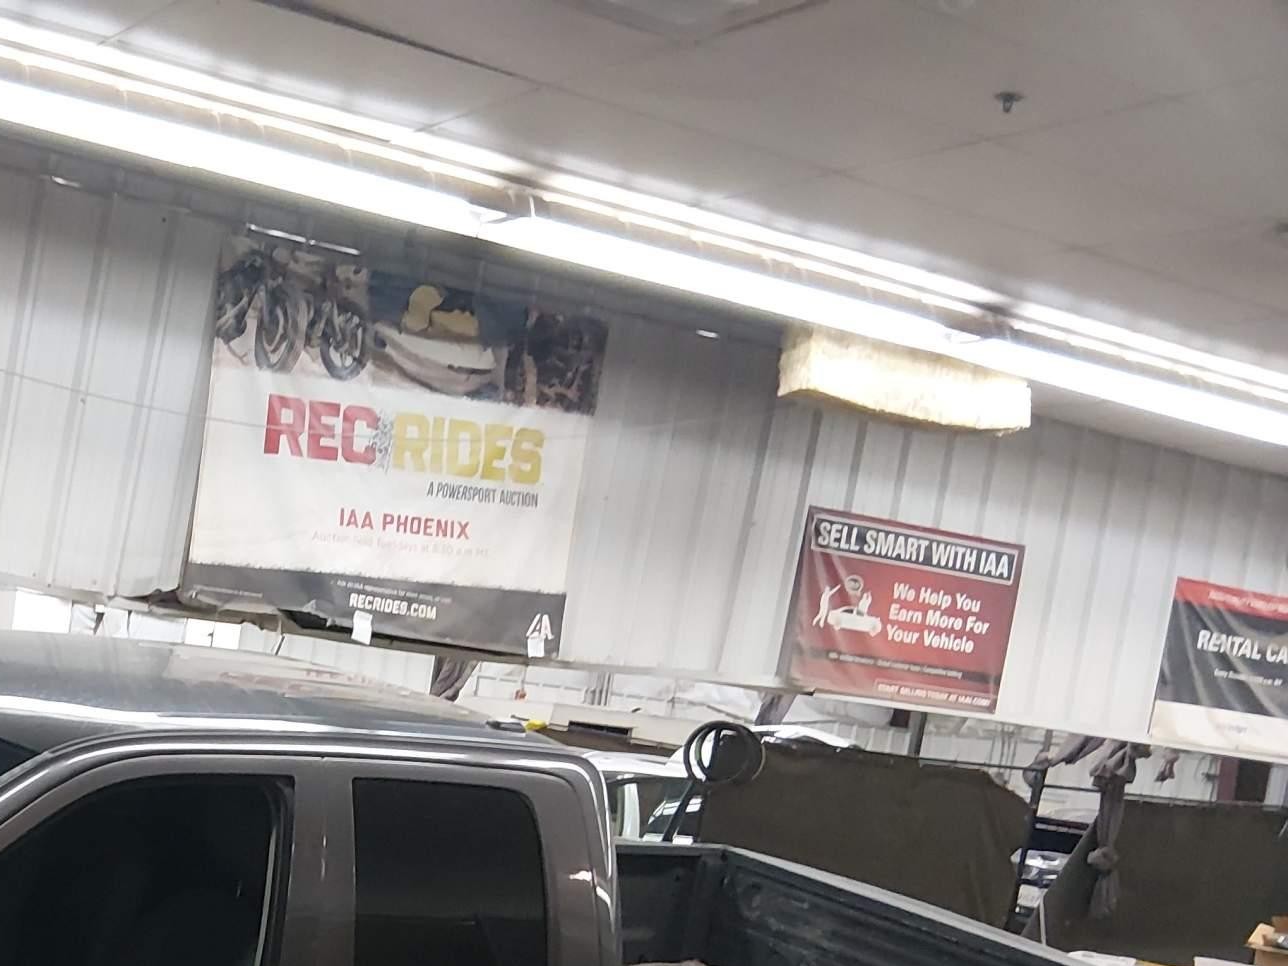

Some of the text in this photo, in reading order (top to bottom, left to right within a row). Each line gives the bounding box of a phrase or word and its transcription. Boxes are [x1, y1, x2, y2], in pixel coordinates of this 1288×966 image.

[263, 393, 545, 485] REC RIDES
[427, 481, 539, 507] A POWERSPORT AUCTION
[339, 508, 472, 540] IAA PHOENIX
[818, 522, 1009, 578] SELL SMART WITH IAA
[349, 593, 437, 620] RECRIDES.COM
[893, 582, 981, 613] We Help You
[889, 603, 990, 635] Earn More For
[886, 625, 975, 653] Your Vehicle
[1197, 629, 1262, 661] RENTAL
